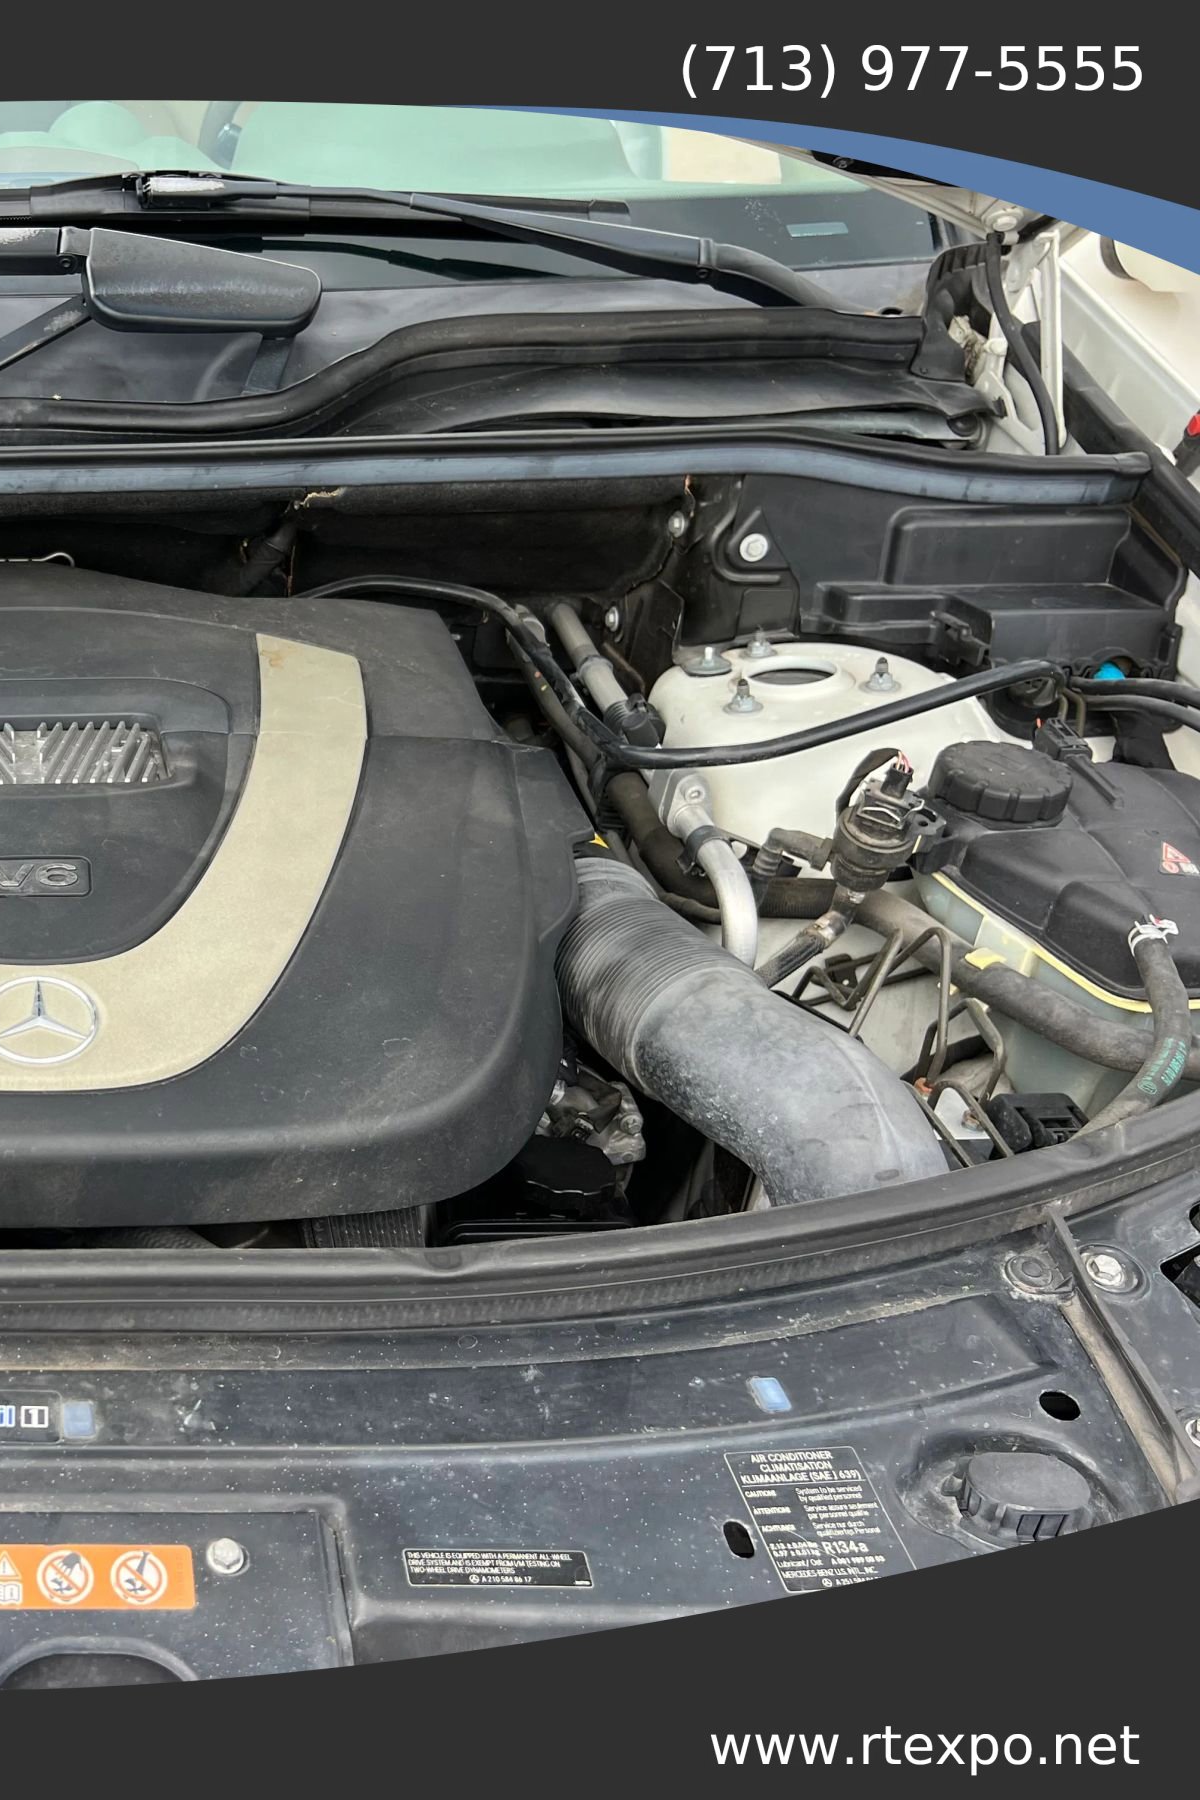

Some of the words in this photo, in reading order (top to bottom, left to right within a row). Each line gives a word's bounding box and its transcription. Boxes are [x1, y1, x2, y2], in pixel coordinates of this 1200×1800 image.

[23, 1407, 45, 1427] 1
[751, 1454, 767, 1463] AIR
[768, 1451, 834, 1462] CONDITIONER
[760, 1461, 833, 1473] CLIMATISATION
[741, 1472, 809, 1484] KLIMAANLAGE
[822, 1540, 869, 1555] R134a
